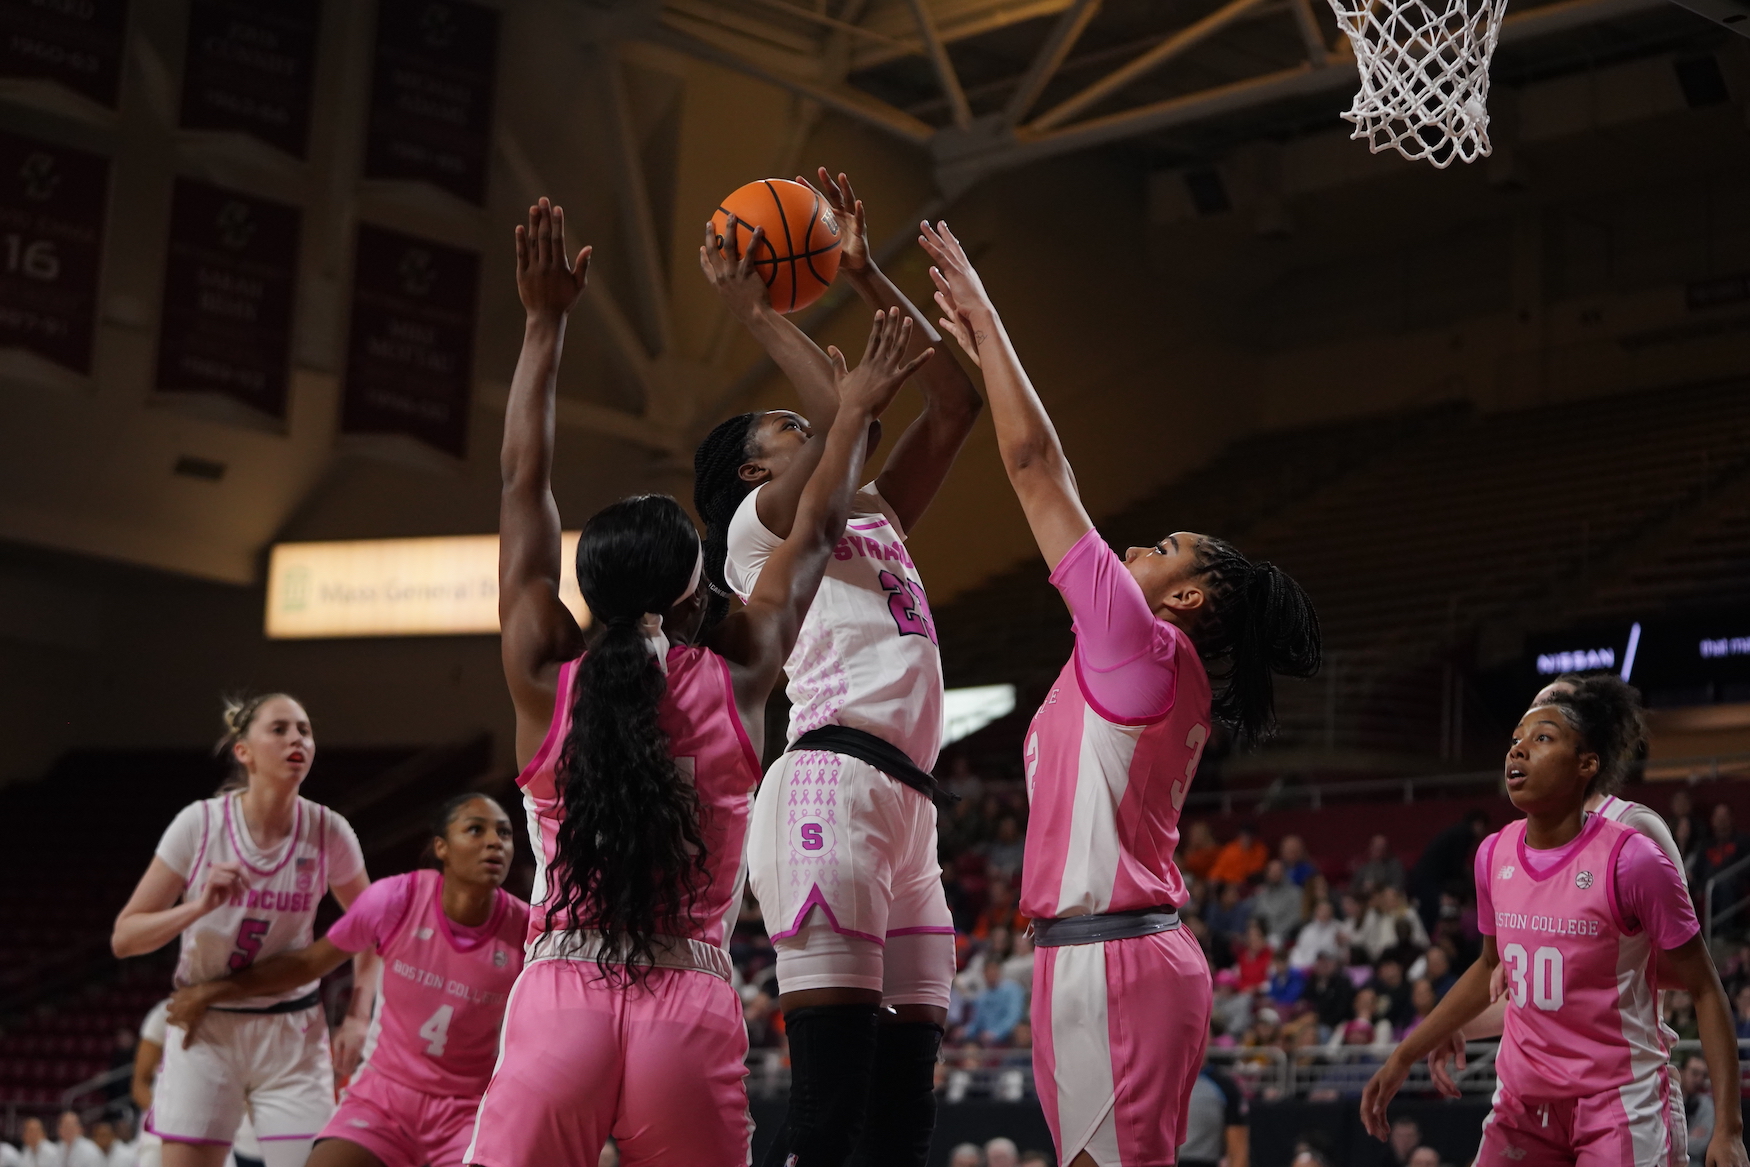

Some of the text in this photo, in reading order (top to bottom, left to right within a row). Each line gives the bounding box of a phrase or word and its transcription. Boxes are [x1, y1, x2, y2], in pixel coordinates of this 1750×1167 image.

[4, 233, 61, 283] 16
[1536, 647, 1615, 675] NISSAN
[800, 823, 823, 850] S
[228, 918, 271, 970] 5
[1531, 915, 1600, 936] COLLEGE
[392, 959, 445, 989] BOSTON
[1504, 943, 1565, 1012] 30
[419, 1004, 454, 1057] 4
